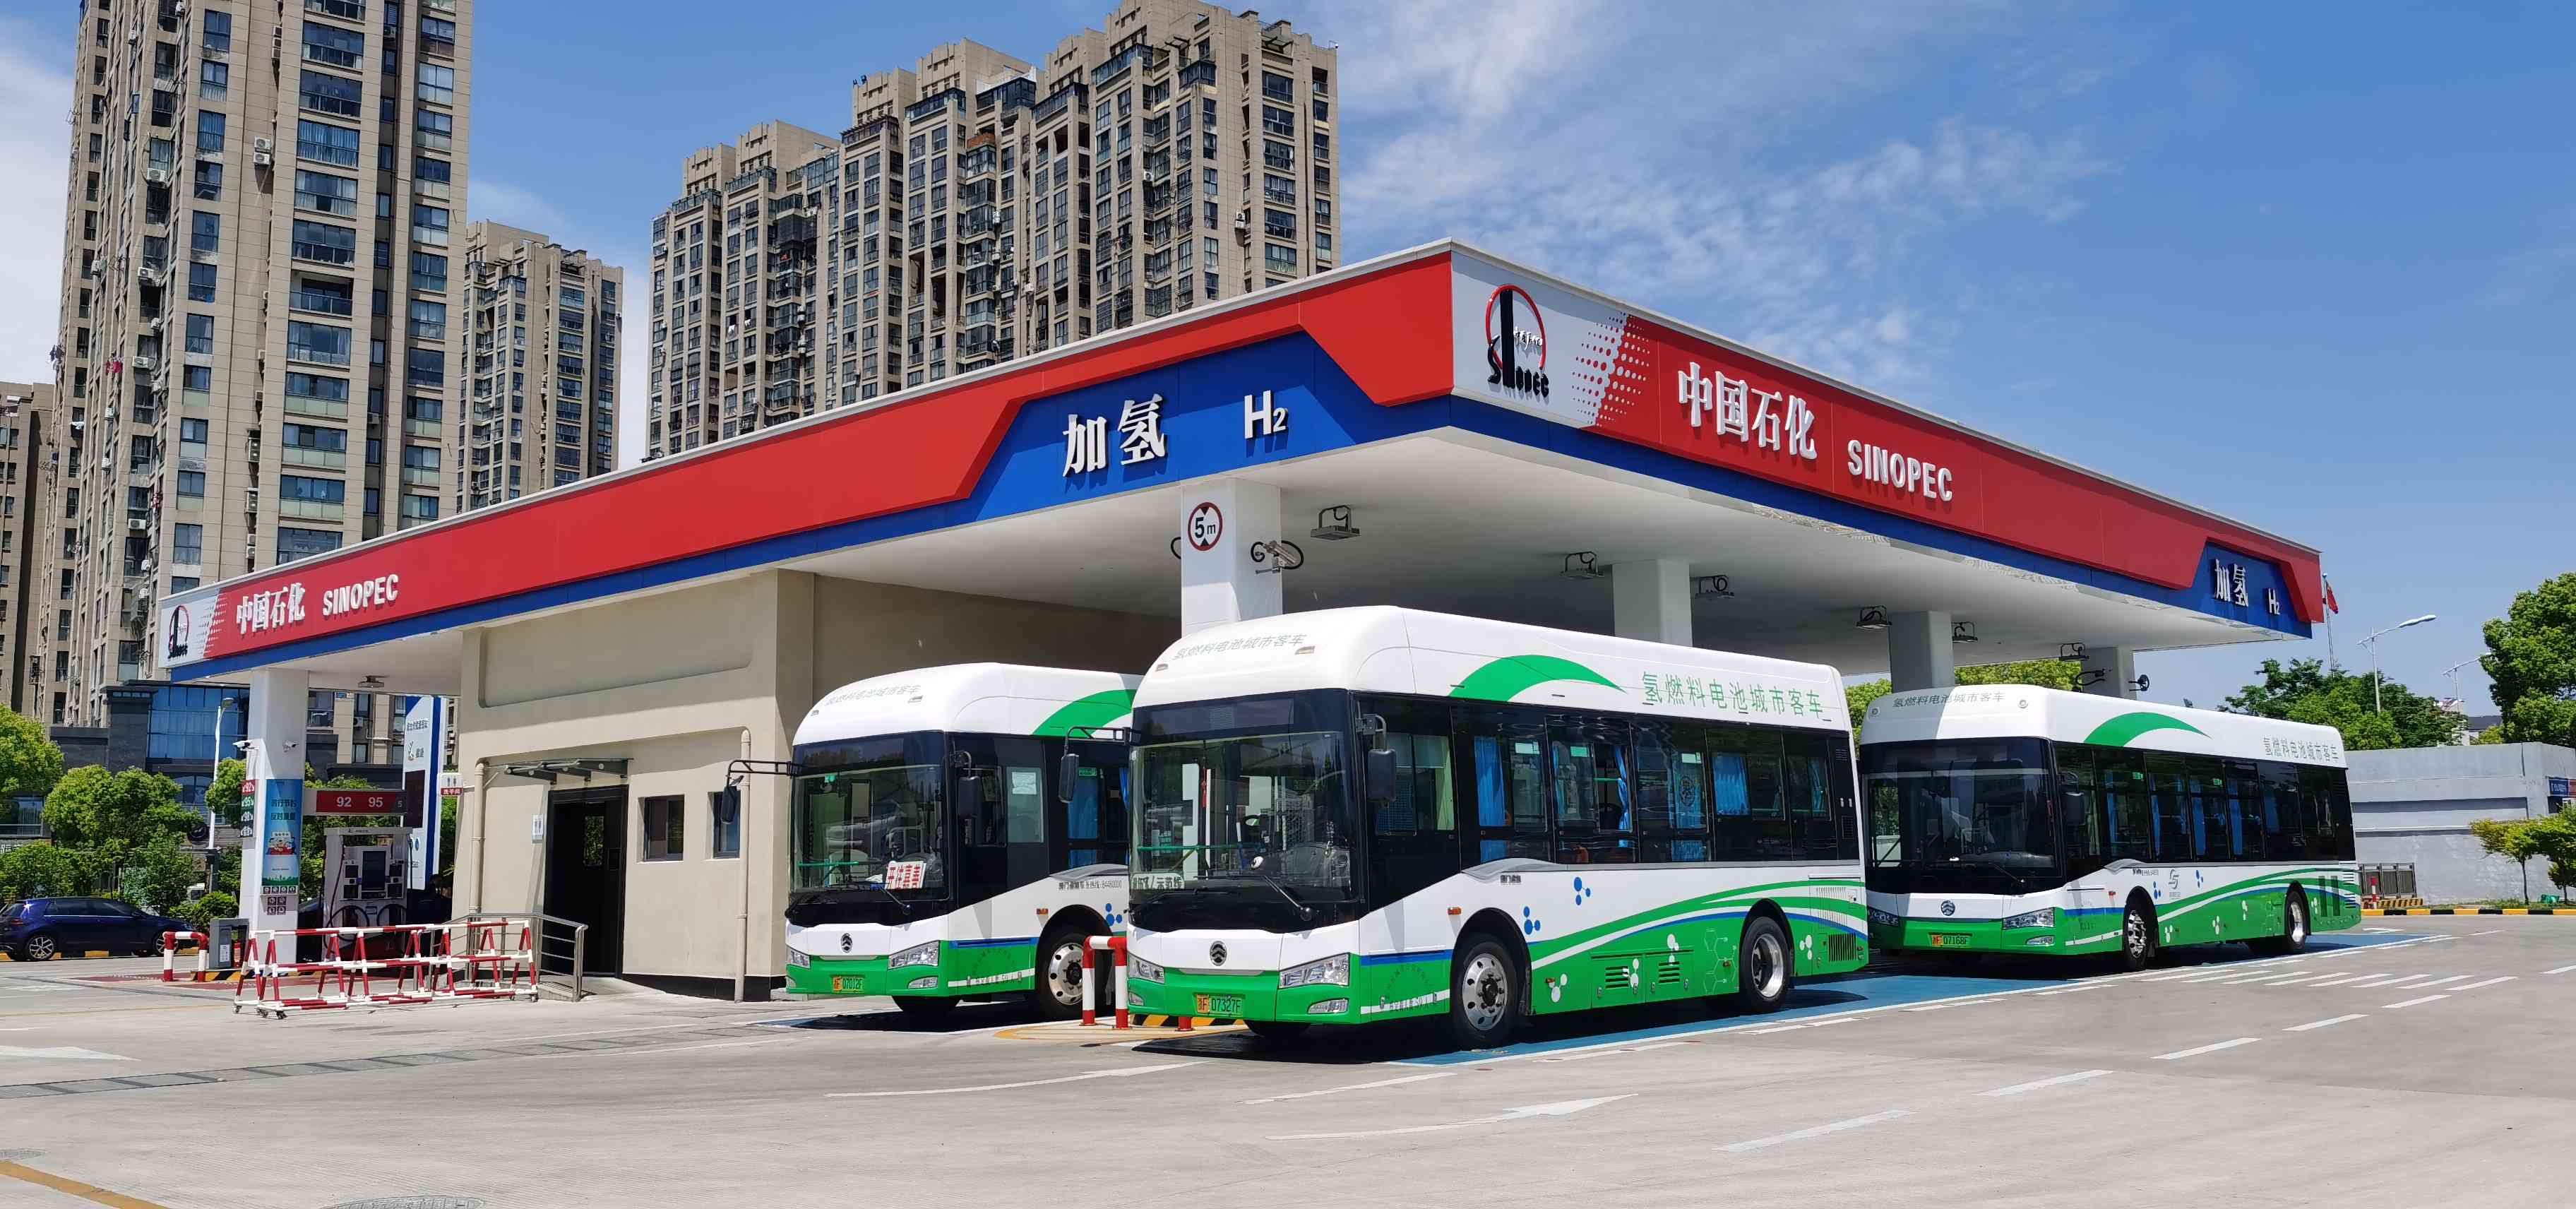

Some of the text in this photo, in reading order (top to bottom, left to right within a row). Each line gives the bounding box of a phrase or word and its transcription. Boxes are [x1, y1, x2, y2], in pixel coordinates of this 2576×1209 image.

[1062, 394, 1168, 477] 加氢
[1678, 362, 1953, 501] 中国石化 SINOPEC
[237, 574, 399, 635] 中国石化 SINOPEC
[2214, 559, 2249, 607] 加氢
[1642, 672, 1823, 718] 氢燃料电池城市客车
[1892, 691, 2005, 708] 氢燃料电池城市客车
[2261, 734, 2339, 763] 氢燃料电池城市客车
[336, 796, 352, 807] 92
[368, 797, 383, 808] 95
[1211, 998, 1241, 1013] 07327F
